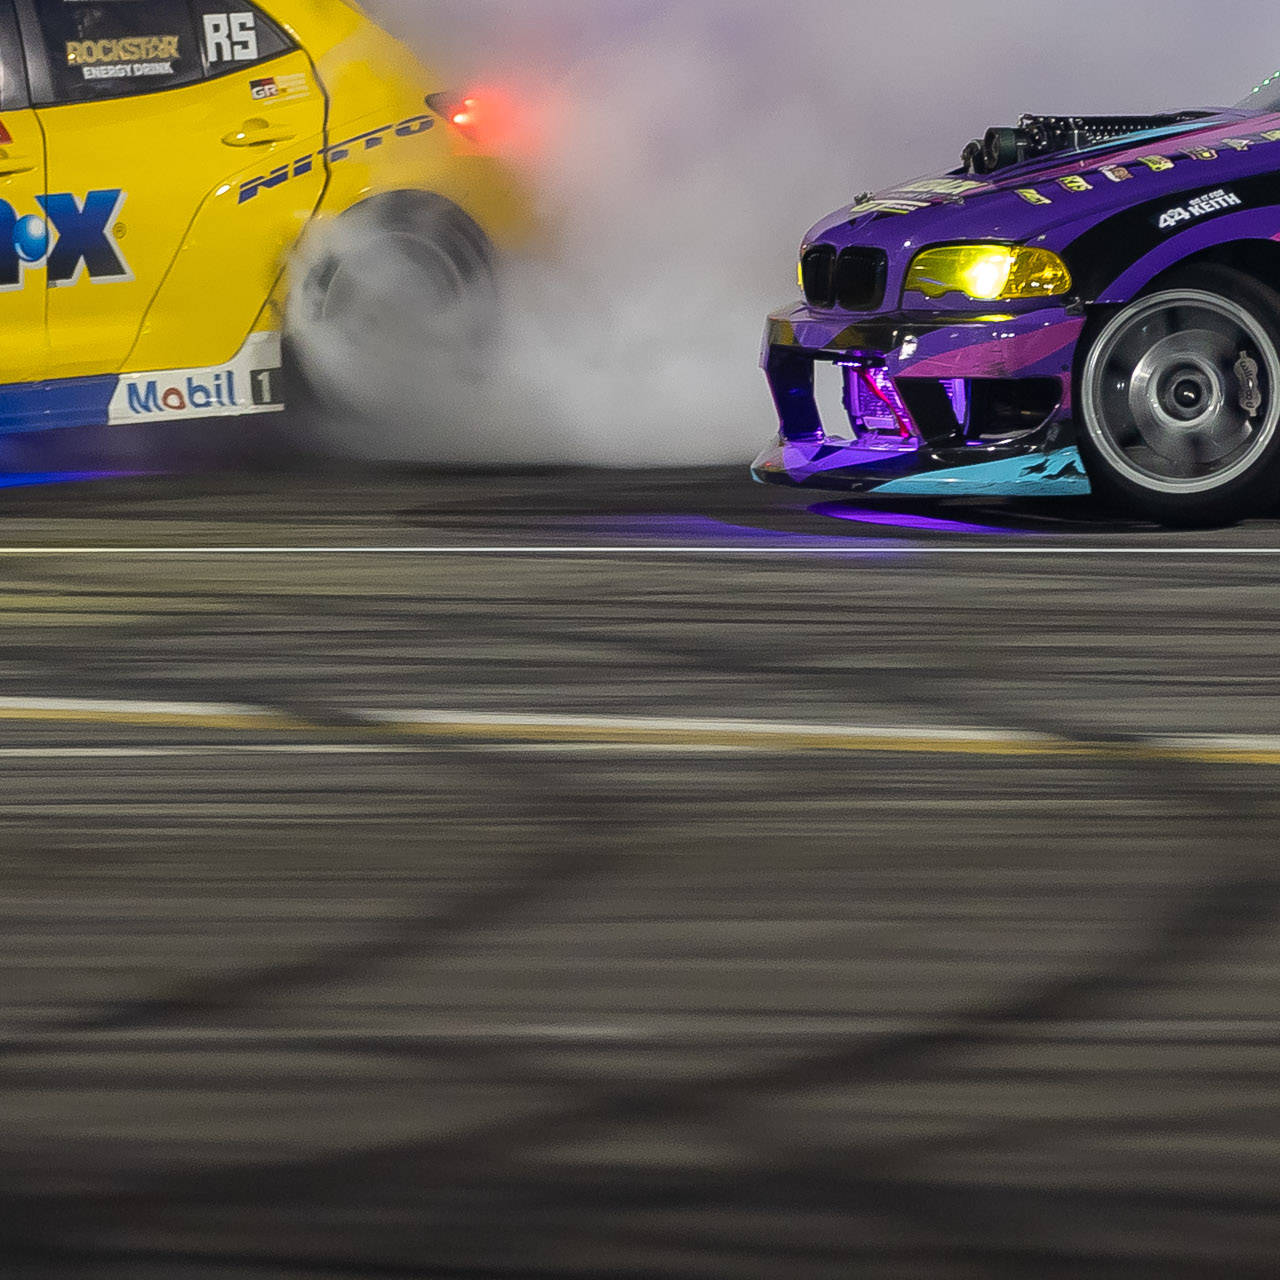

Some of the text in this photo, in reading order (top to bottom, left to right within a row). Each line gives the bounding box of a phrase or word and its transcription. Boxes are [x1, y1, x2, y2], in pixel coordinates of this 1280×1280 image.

[66, 35, 180, 66] ROCKSTAR
[203, 12, 259, 63] RS
[82, 65, 132, 79] ENERGY
[251, 84, 279, 100] GR
[238, 114, 435, 205] NITTO
[1158, 192, 1242, 229] 44 KEITH
[127, 370, 272, 414] Mobil 1
